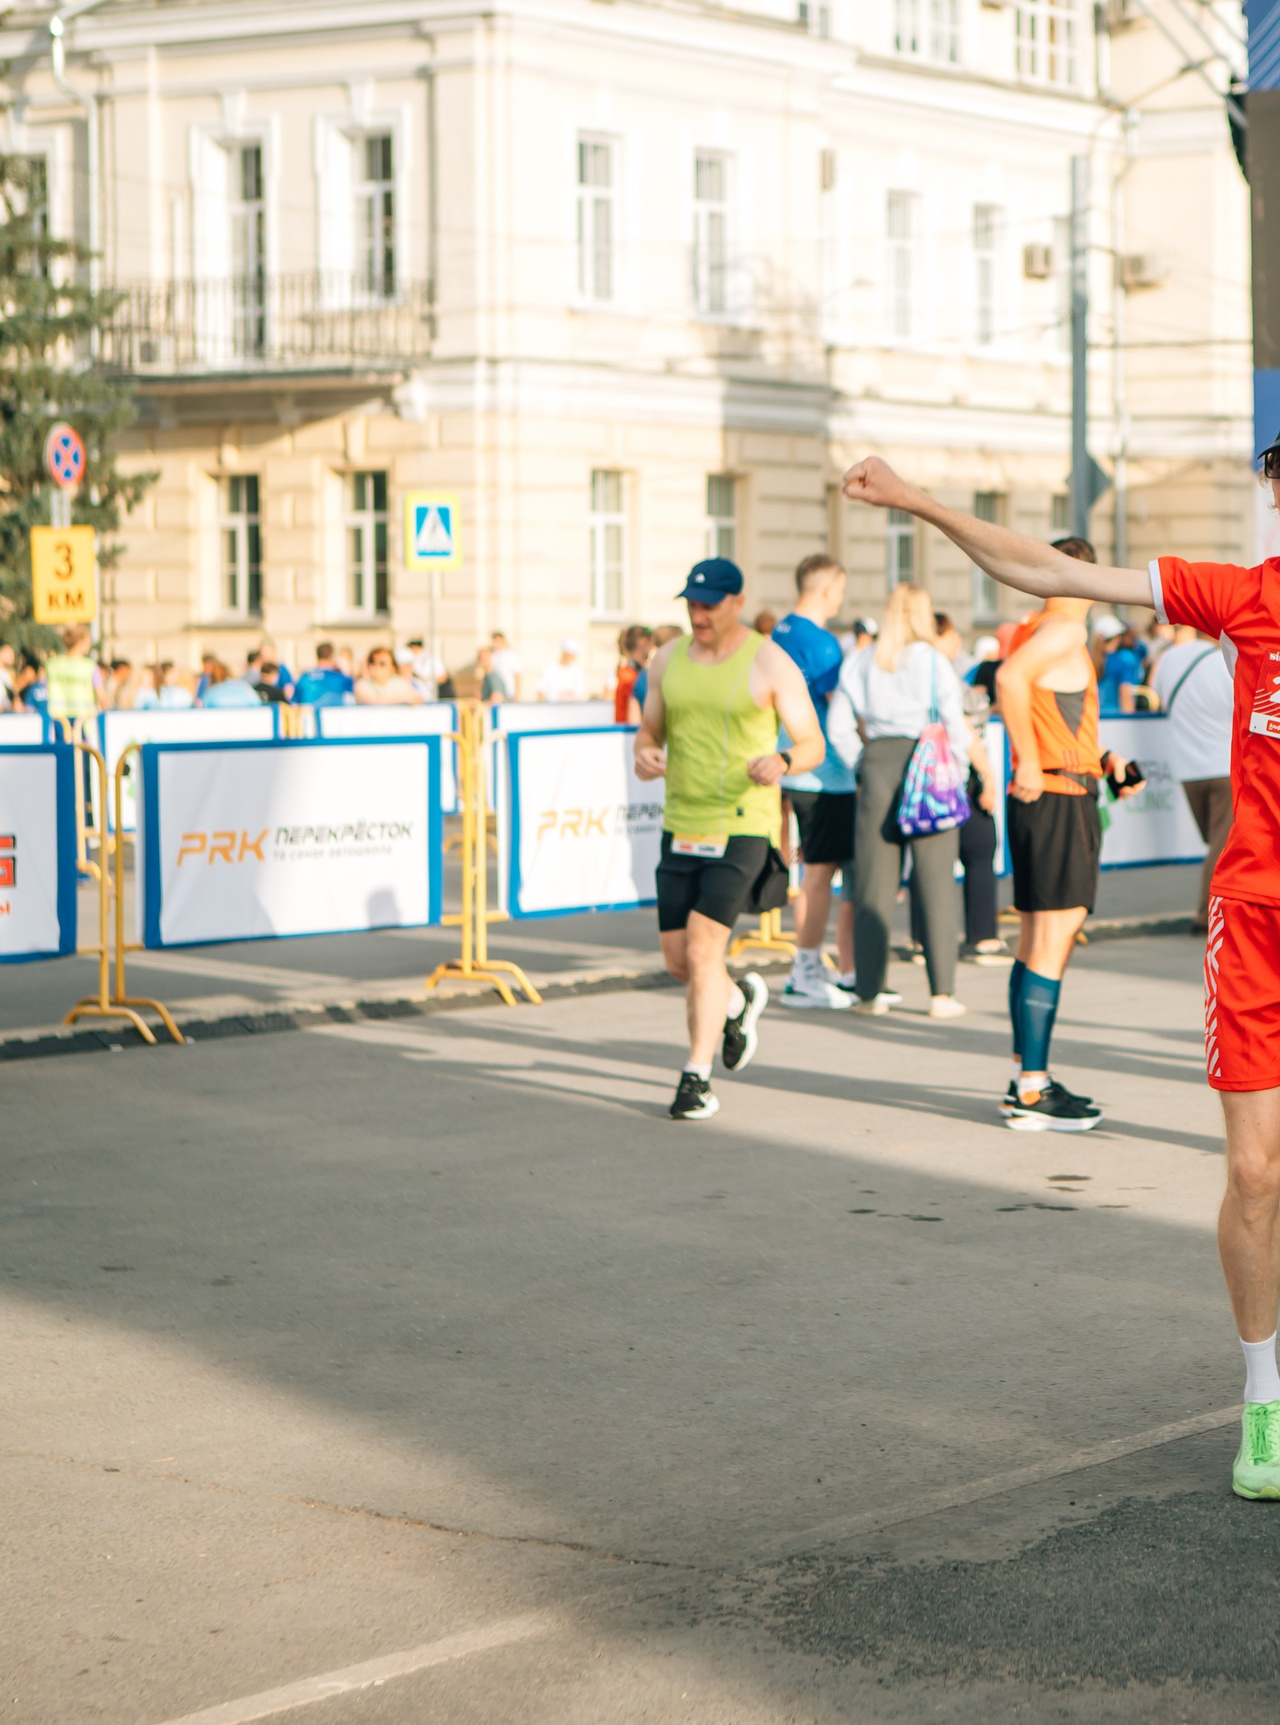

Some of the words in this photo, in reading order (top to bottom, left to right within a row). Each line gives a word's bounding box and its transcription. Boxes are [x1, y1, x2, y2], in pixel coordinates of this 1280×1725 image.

[55, 541, 75, 580] 3
[47, 590, 84, 610] КМ
[275, 818, 413, 845] ПЕРЕКРЁСТОК
[536, 806, 611, 841] PRK
[177, 827, 270, 867] PRK
